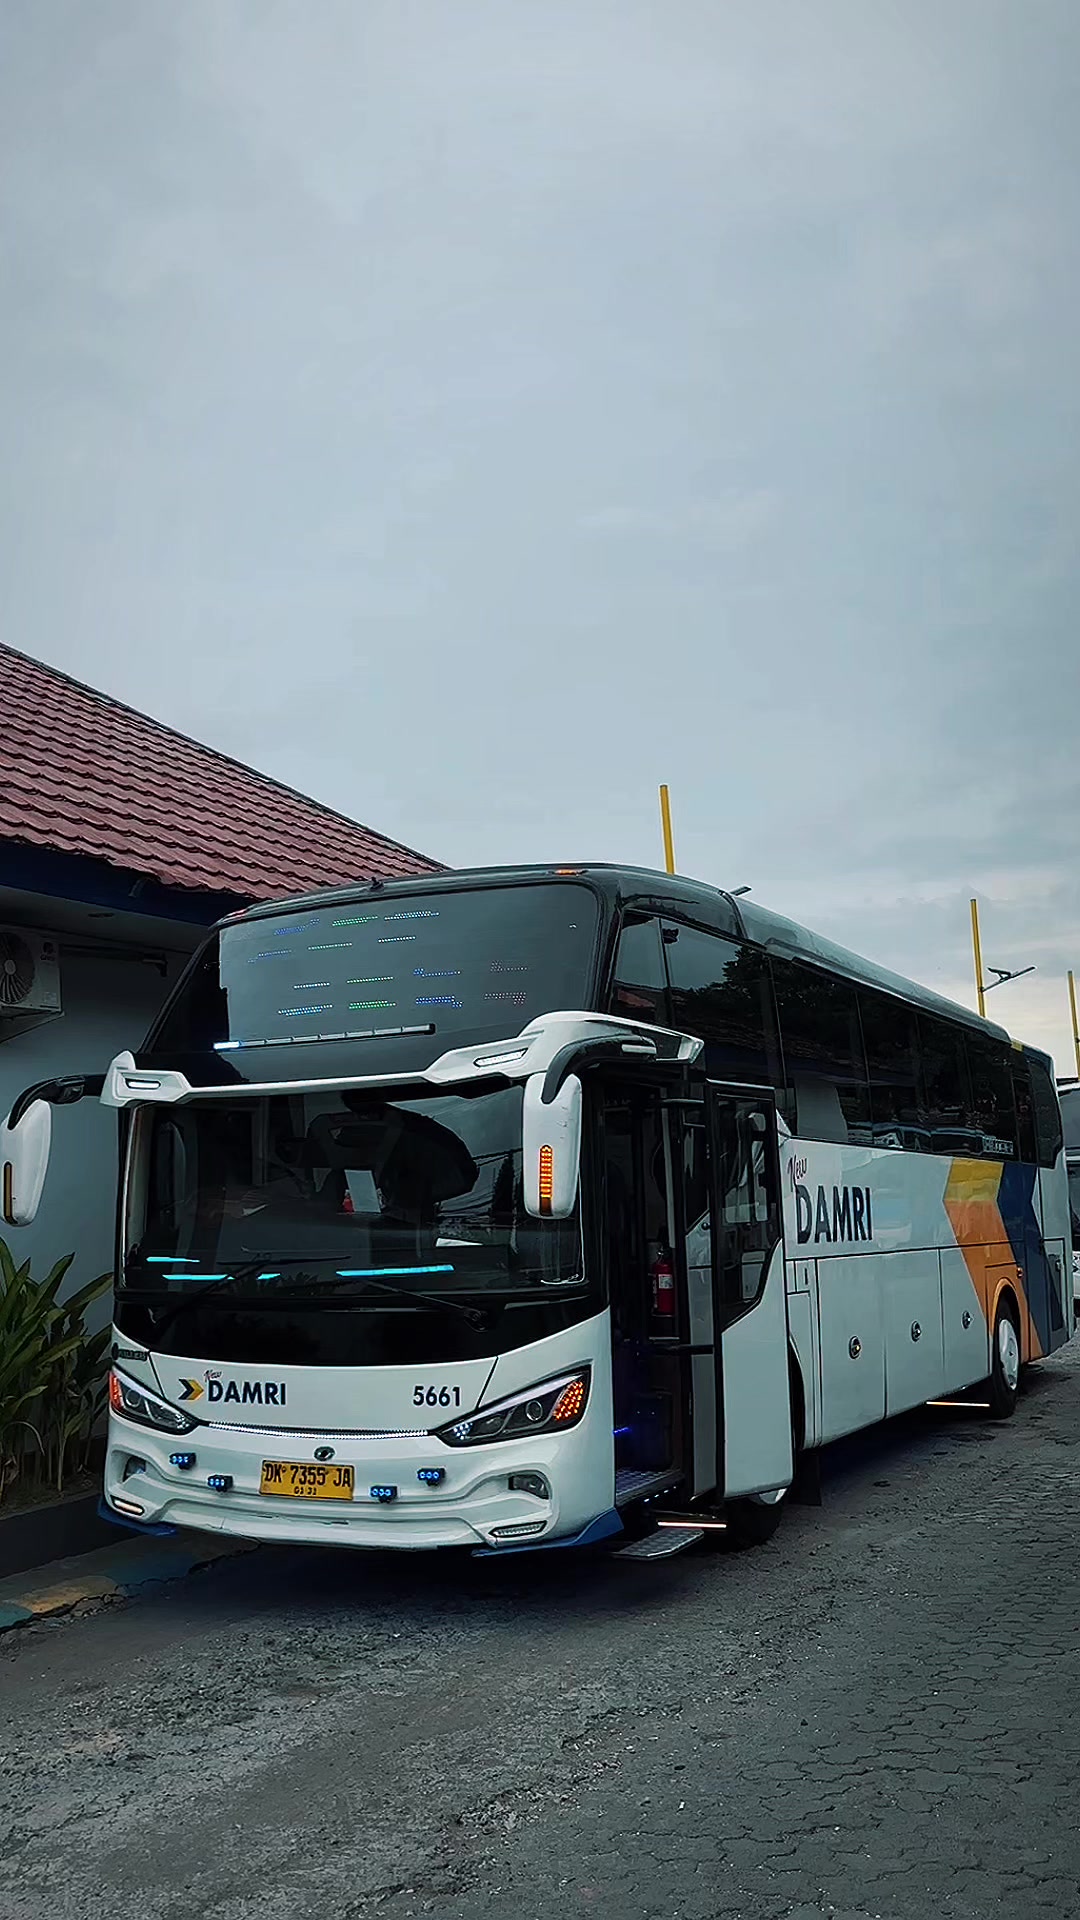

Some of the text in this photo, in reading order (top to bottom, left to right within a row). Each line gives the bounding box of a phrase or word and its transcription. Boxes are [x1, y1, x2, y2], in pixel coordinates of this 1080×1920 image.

[787, 1154, 808, 1193] New
[796, 1184, 873, 1244] DAMRI
[203, 1369, 222, 1382] New
[207, 1380, 287, 1405] DAMRI
[412, 1385, 461, 1407] 5661
[264, 1463, 351, 1487] DK 7355 JA
